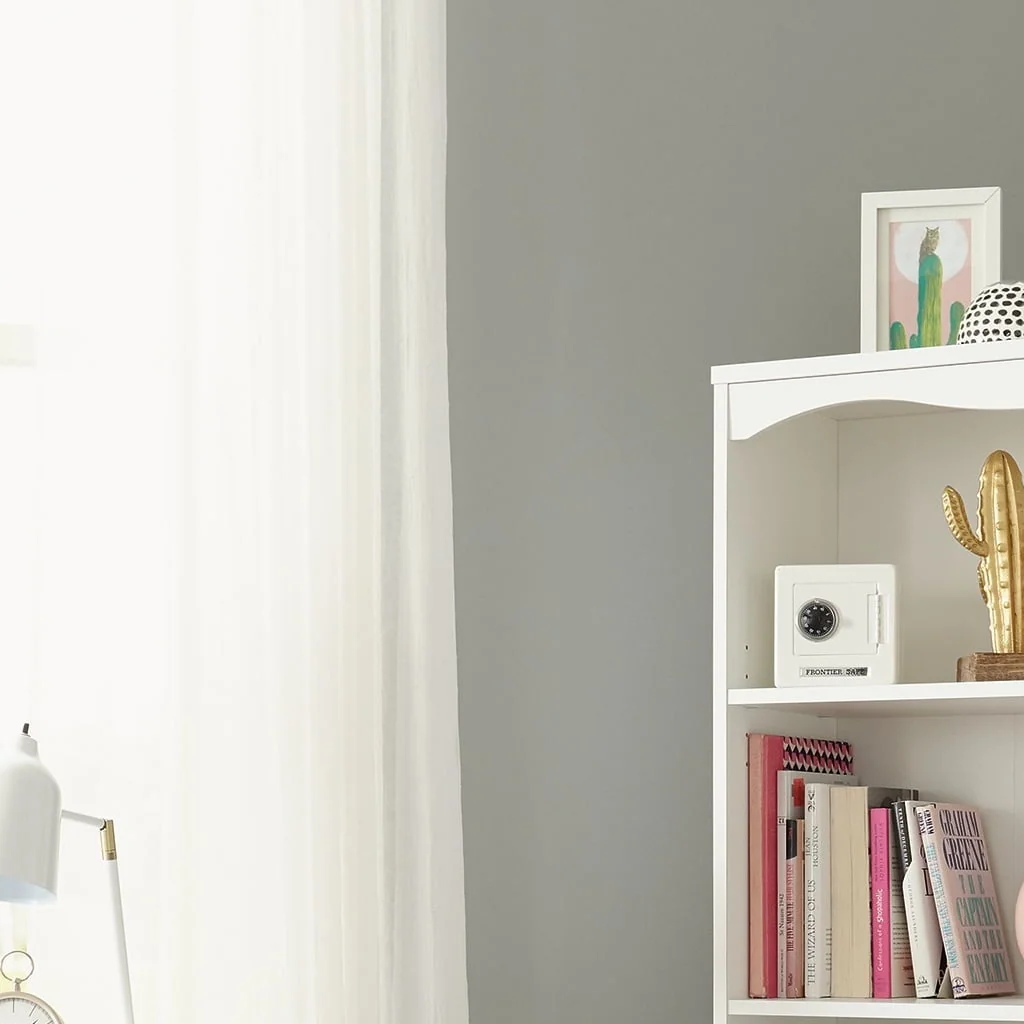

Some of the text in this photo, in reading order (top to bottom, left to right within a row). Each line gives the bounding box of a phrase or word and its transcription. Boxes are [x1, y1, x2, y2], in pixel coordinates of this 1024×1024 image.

[805, 668, 843, 676] FRONTIER
[939, 809, 980, 837] GRAHAM
[943, 837, 989, 871] GREENE
[958, 874, 985, 895] THE
[875, 888, 884, 923] Shopaholic
[786, 940, 794, 952] THE
[807, 879, 816, 986] THE WIZARD OF US
